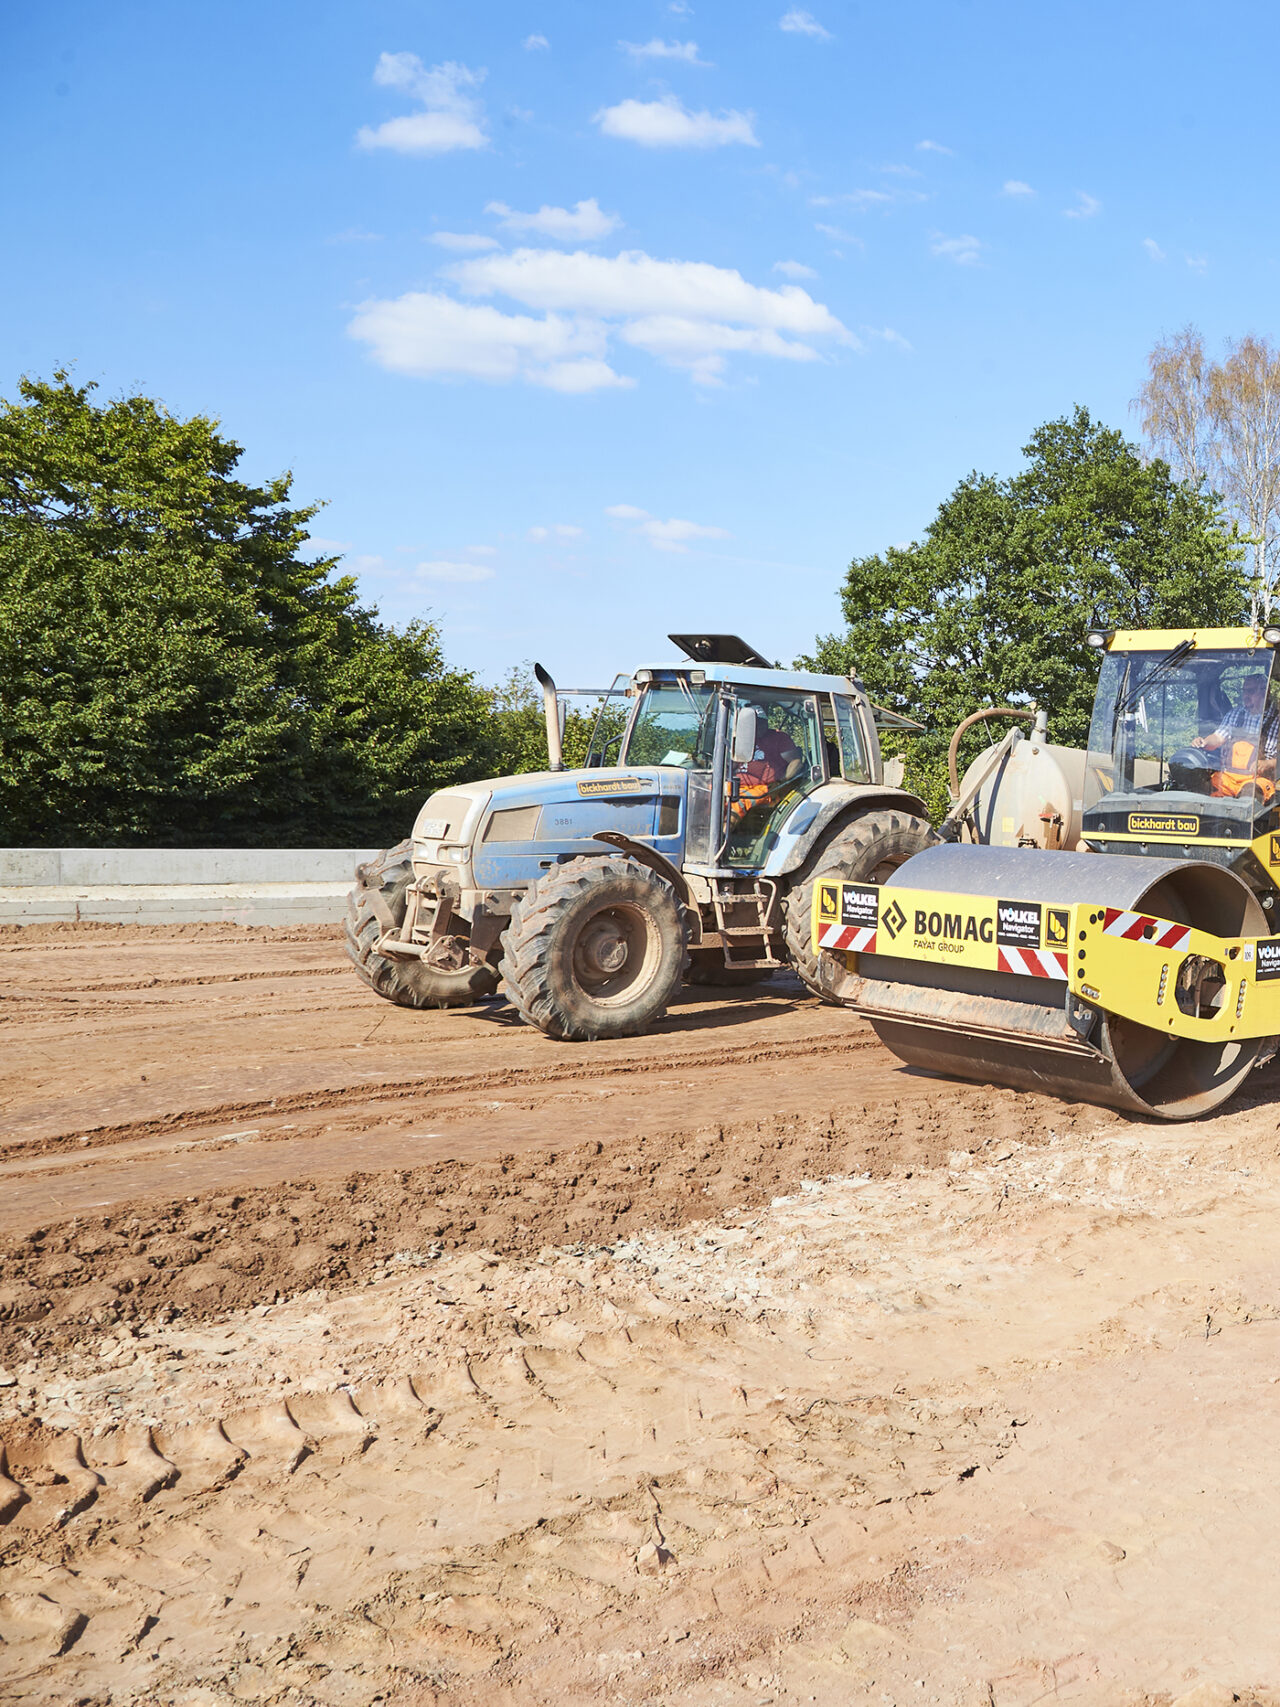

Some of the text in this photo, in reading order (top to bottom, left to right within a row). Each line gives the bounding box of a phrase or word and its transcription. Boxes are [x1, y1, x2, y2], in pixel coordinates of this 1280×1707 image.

[581, 782, 622, 794] bickhardt
[1131, 817, 1197, 831] bickhardt bau
[846, 904, 875, 915] Navigator
[914, 910, 993, 943] BOMAG
[1003, 922, 1035, 934] Navigator
[913, 939, 965, 954] FAYAT GROUP
